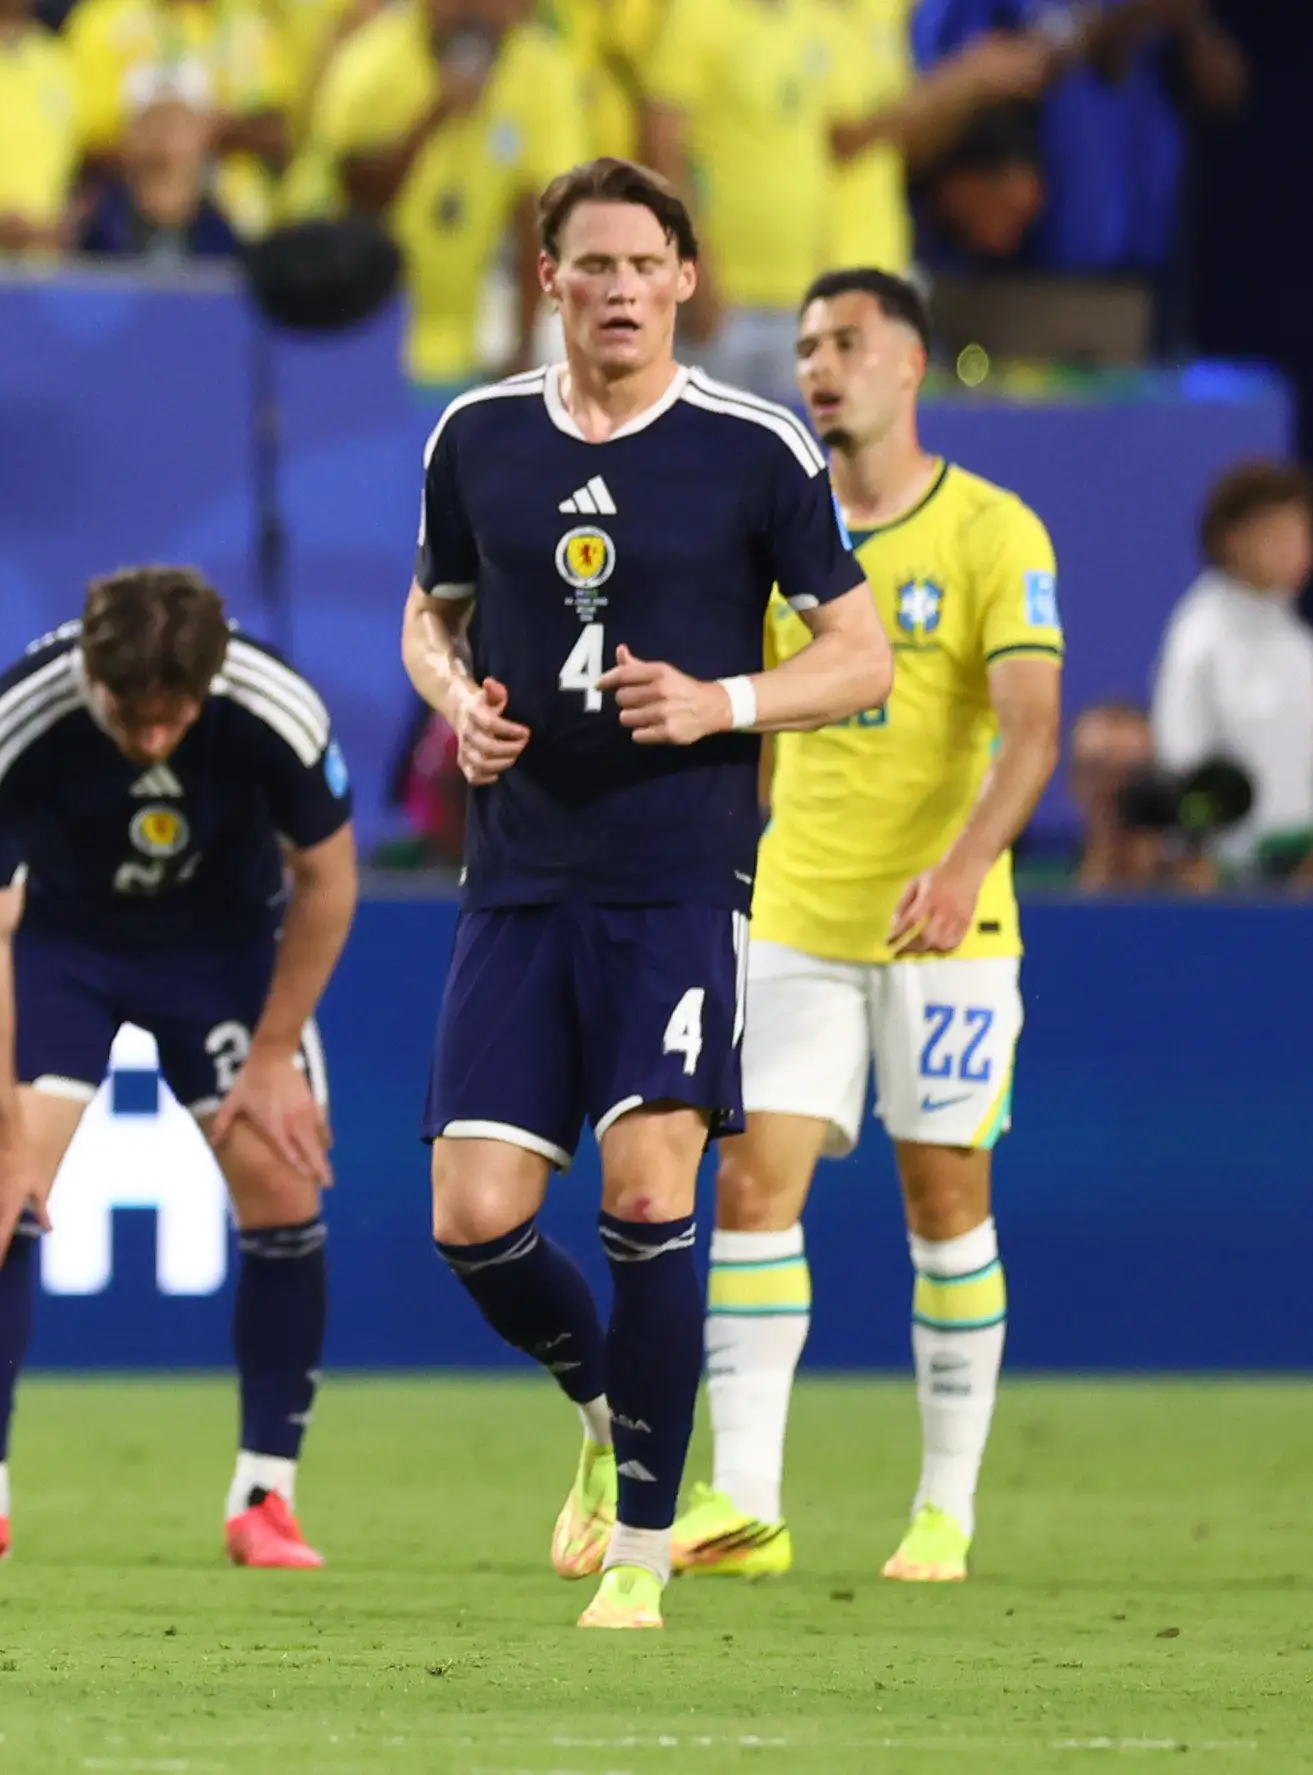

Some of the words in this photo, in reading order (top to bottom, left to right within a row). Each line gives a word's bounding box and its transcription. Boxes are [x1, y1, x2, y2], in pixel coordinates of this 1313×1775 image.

[558, 622, 605, 713] 4
[663, 986, 706, 1076] 4
[918, 1003, 994, 1083] 22
